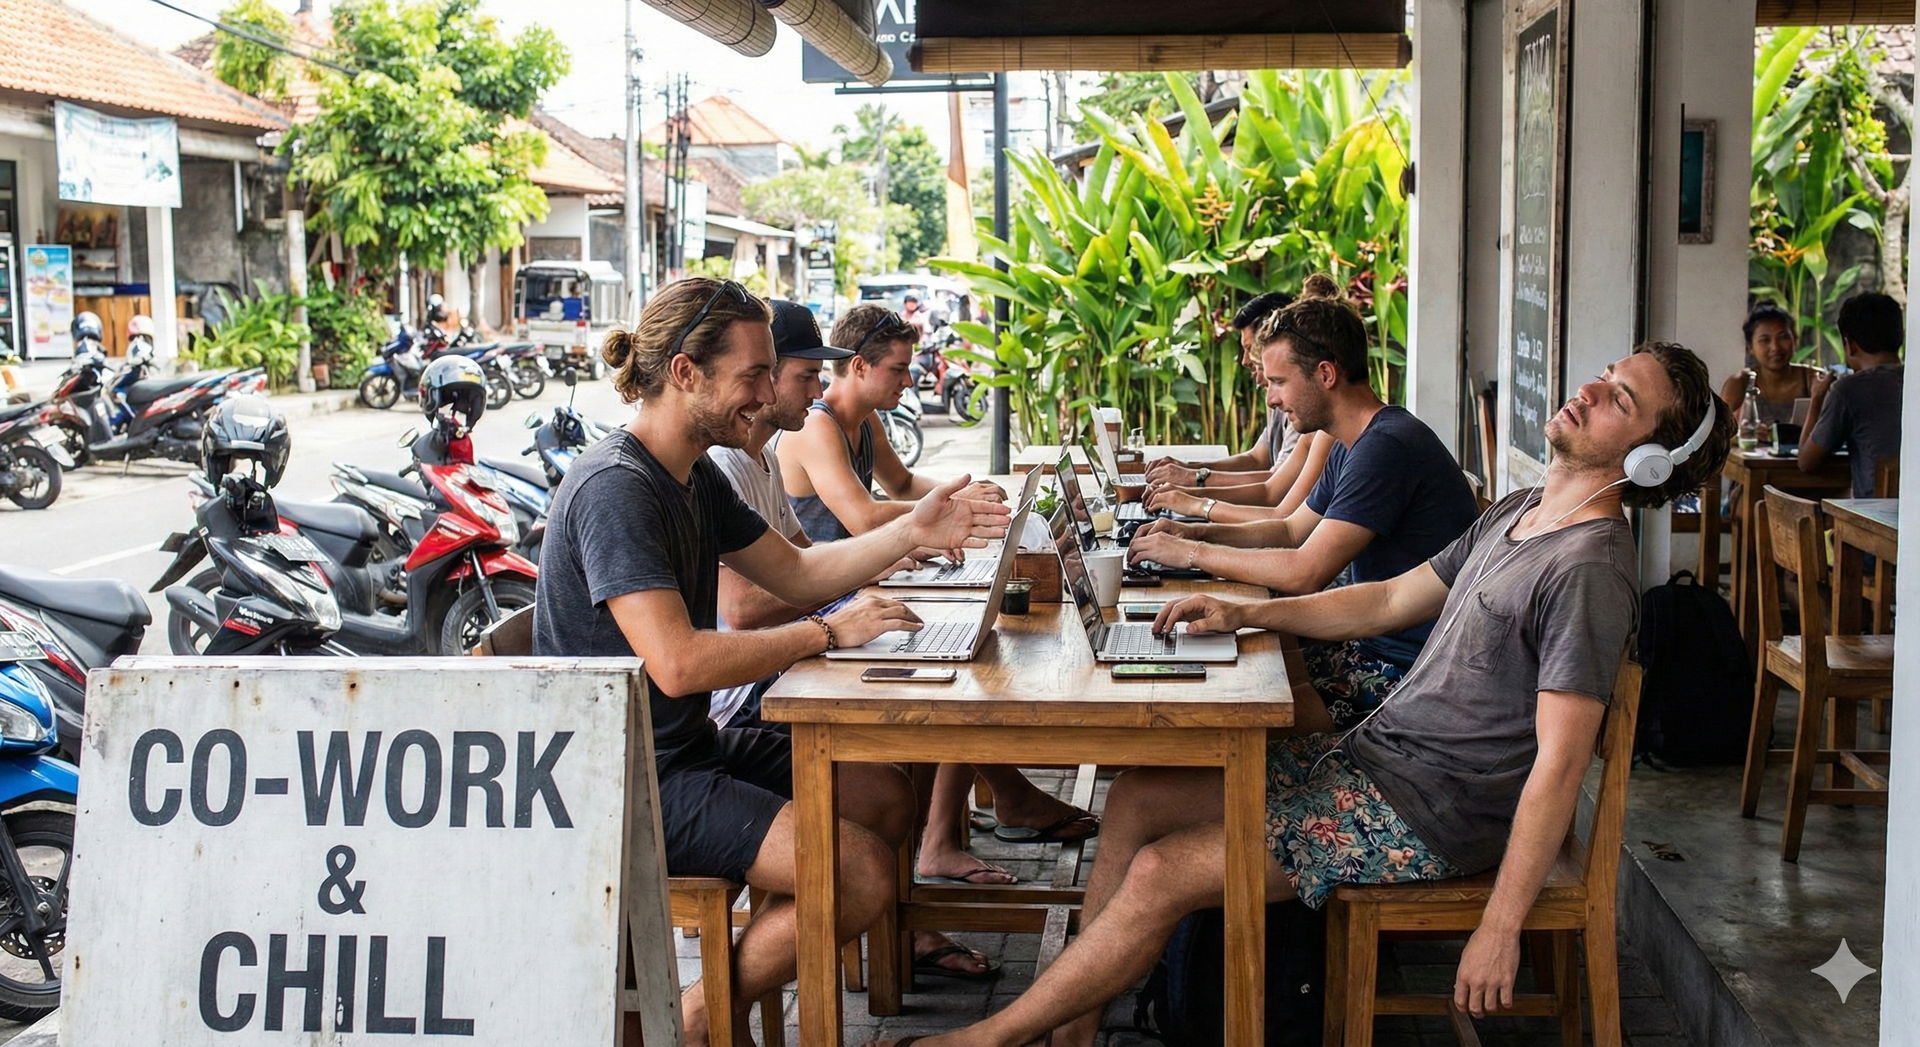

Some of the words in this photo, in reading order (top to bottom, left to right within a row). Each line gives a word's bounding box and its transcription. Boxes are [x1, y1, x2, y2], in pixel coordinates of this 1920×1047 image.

[128, 728, 575, 829] CO-WORK
[317, 844, 367, 915] &
[198, 931, 475, 1037] CHILL
